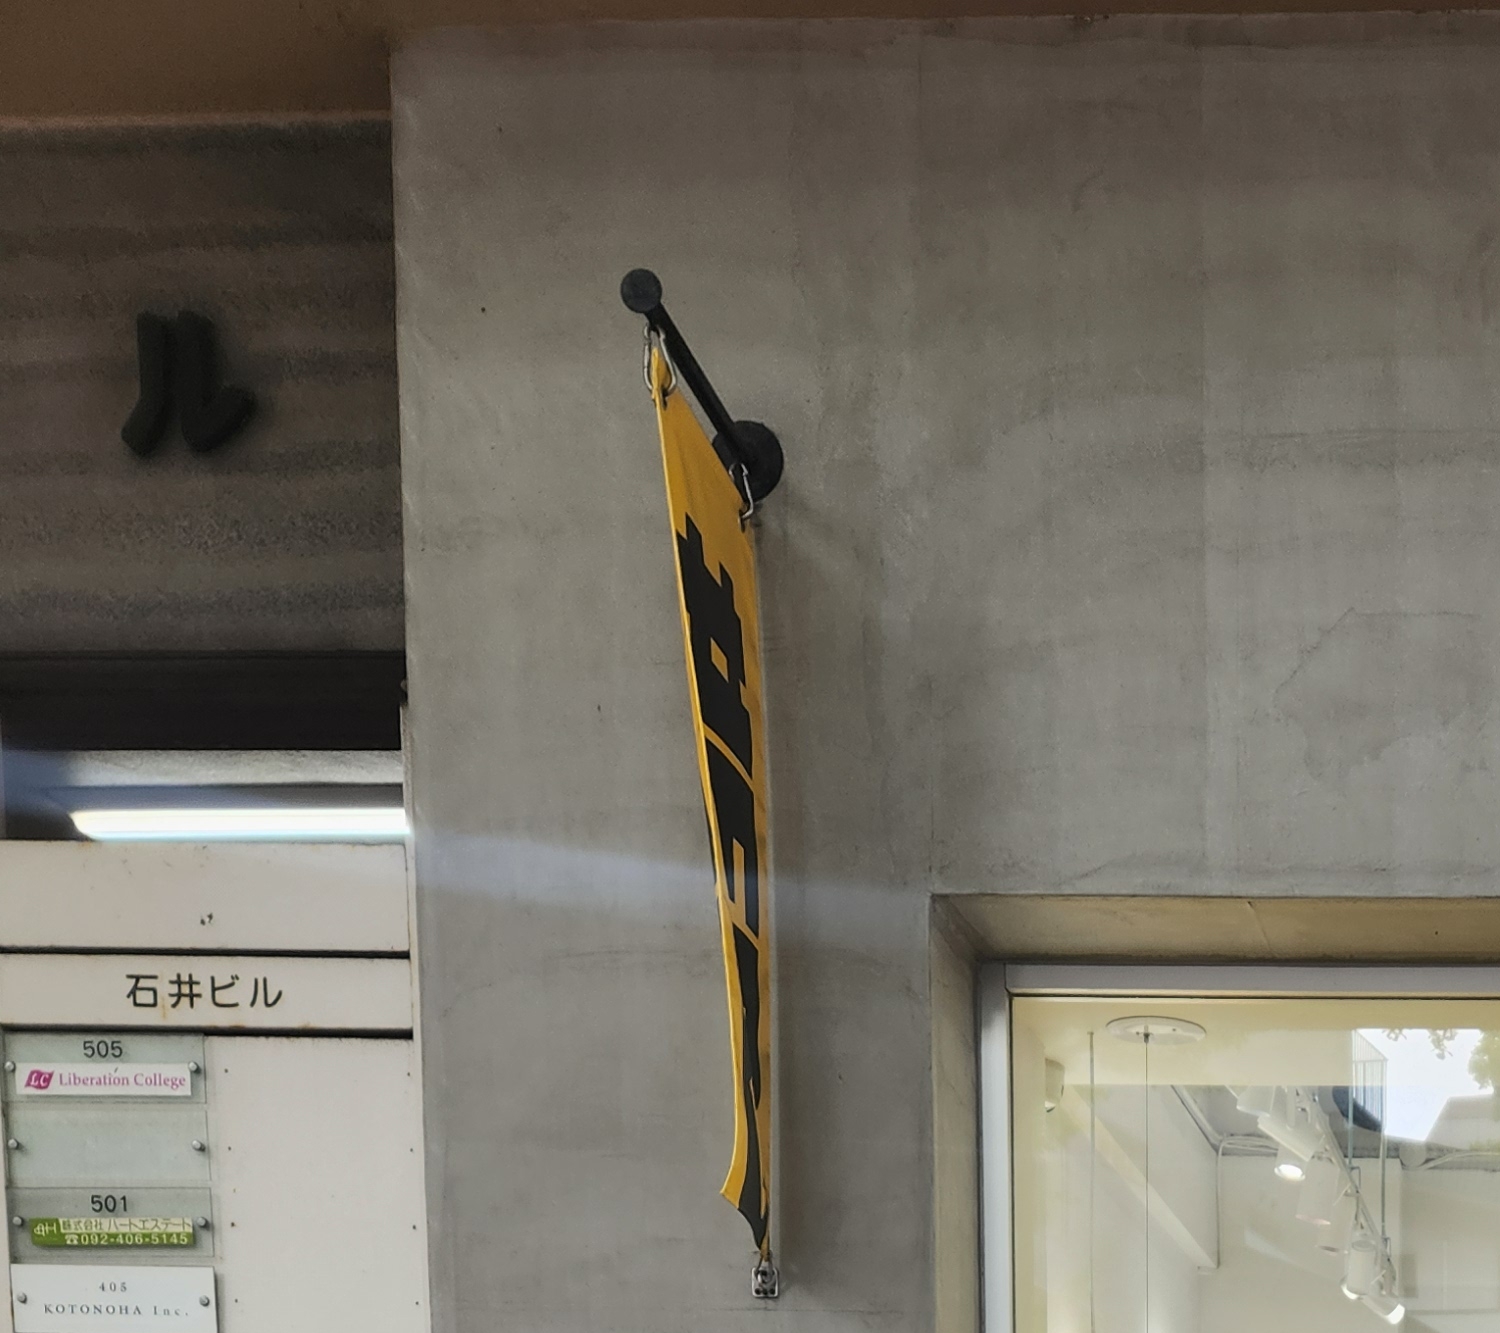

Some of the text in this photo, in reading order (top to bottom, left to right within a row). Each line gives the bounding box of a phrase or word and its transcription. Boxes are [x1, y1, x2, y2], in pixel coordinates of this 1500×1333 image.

[126, 973, 283, 1009] 石井ビル
[83, 1040, 123, 1058] 505
[59, 1073, 129, 1086] Liberation
[134, 1073, 186, 1089] College
[91, 1195, 128, 1212] 501
[81, 1234, 188, 1245] 092-406-5145
[99, 1282, 127, 1292] 405
[44, 1304, 189, 1316] KOTONOHA Inc.
